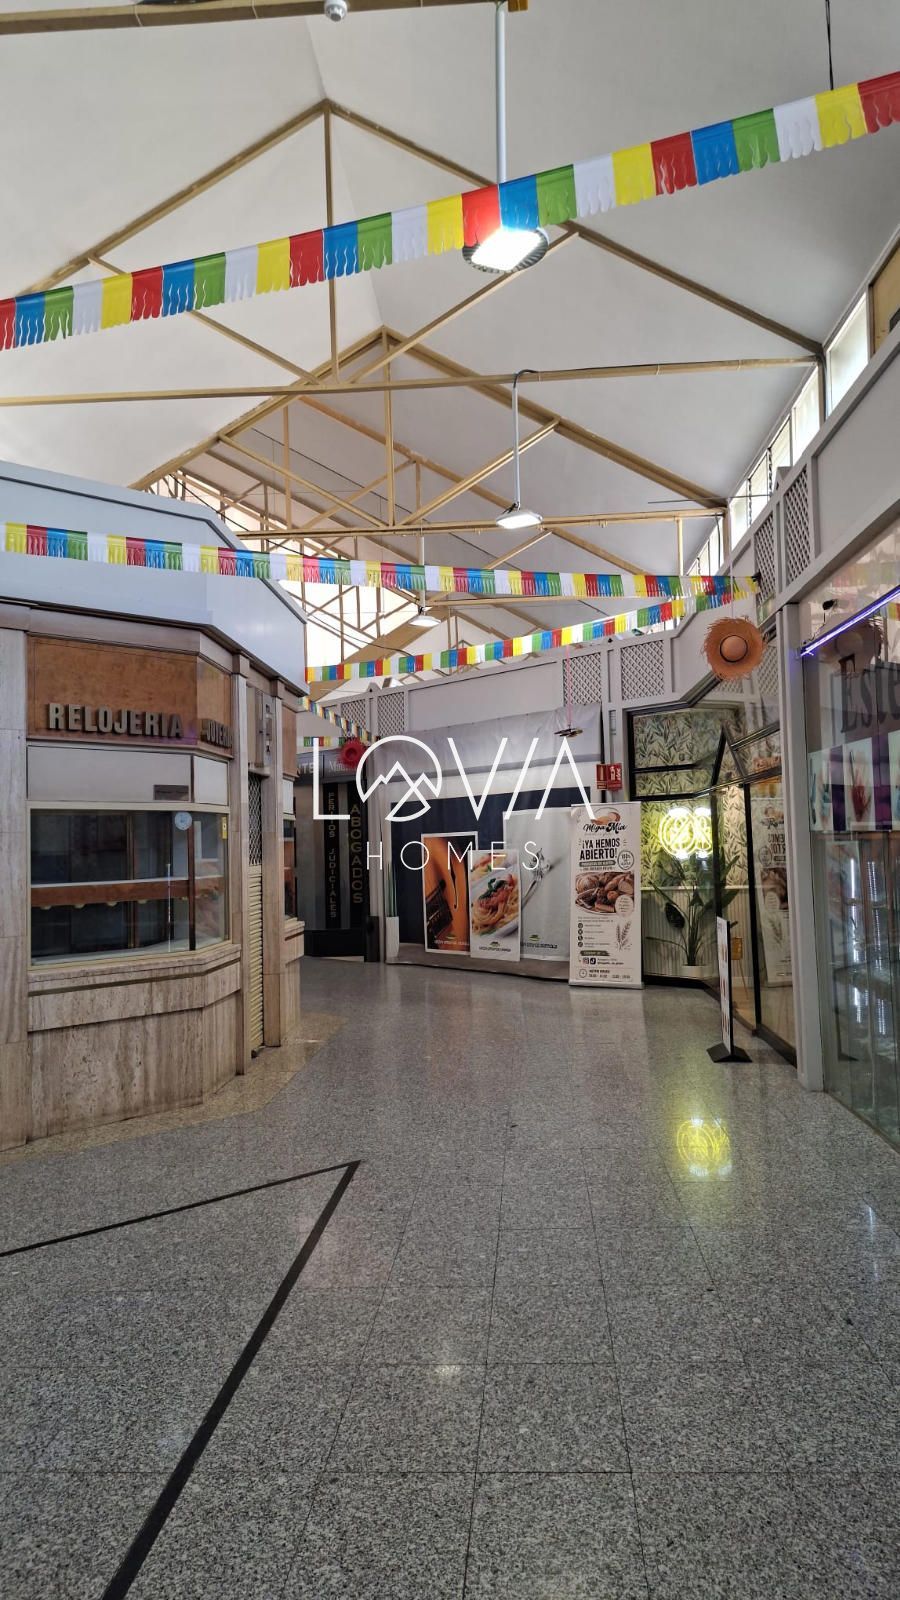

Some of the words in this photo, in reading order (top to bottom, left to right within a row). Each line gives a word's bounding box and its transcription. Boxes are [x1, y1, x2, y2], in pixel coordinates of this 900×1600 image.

[48, 703, 183, 738] RELOJERIA
[350, 803, 363, 903] ABOGADOS
[580, 848, 617, 860] ABIERTO!
[595, 838, 620, 848] HEMOS
